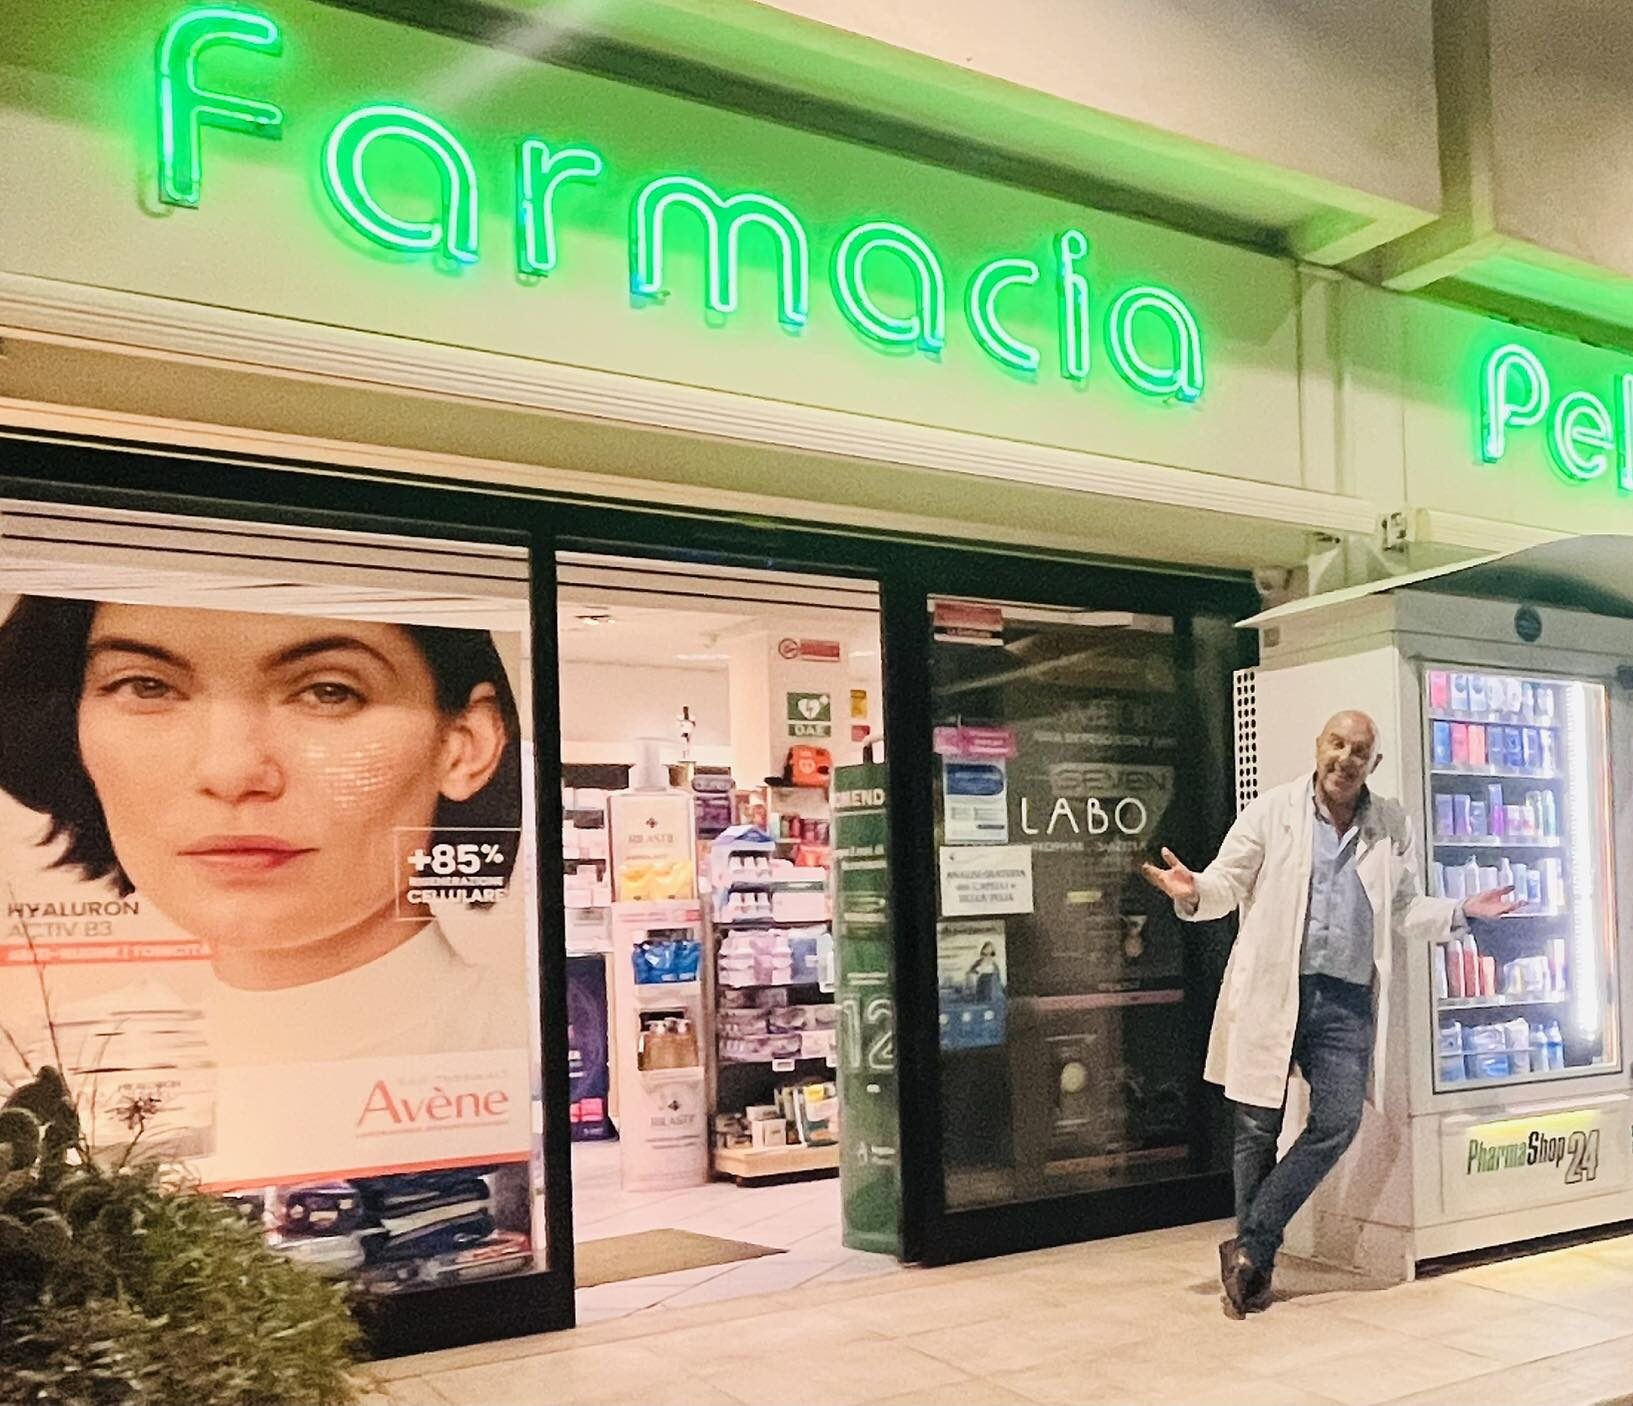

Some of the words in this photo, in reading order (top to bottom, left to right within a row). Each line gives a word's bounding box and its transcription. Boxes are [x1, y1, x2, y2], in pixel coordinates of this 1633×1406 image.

[156, 6, 1206, 404] Farmacia
[1021, 797, 1147, 835] LABO
[407, 843, 505, 875] +85%
[7, 901, 140, 919] HYALURON
[406, 888, 508, 904] CELLULARE
[7, 922, 79, 938] ACTIV
[356, 1080, 509, 1128] Avène
